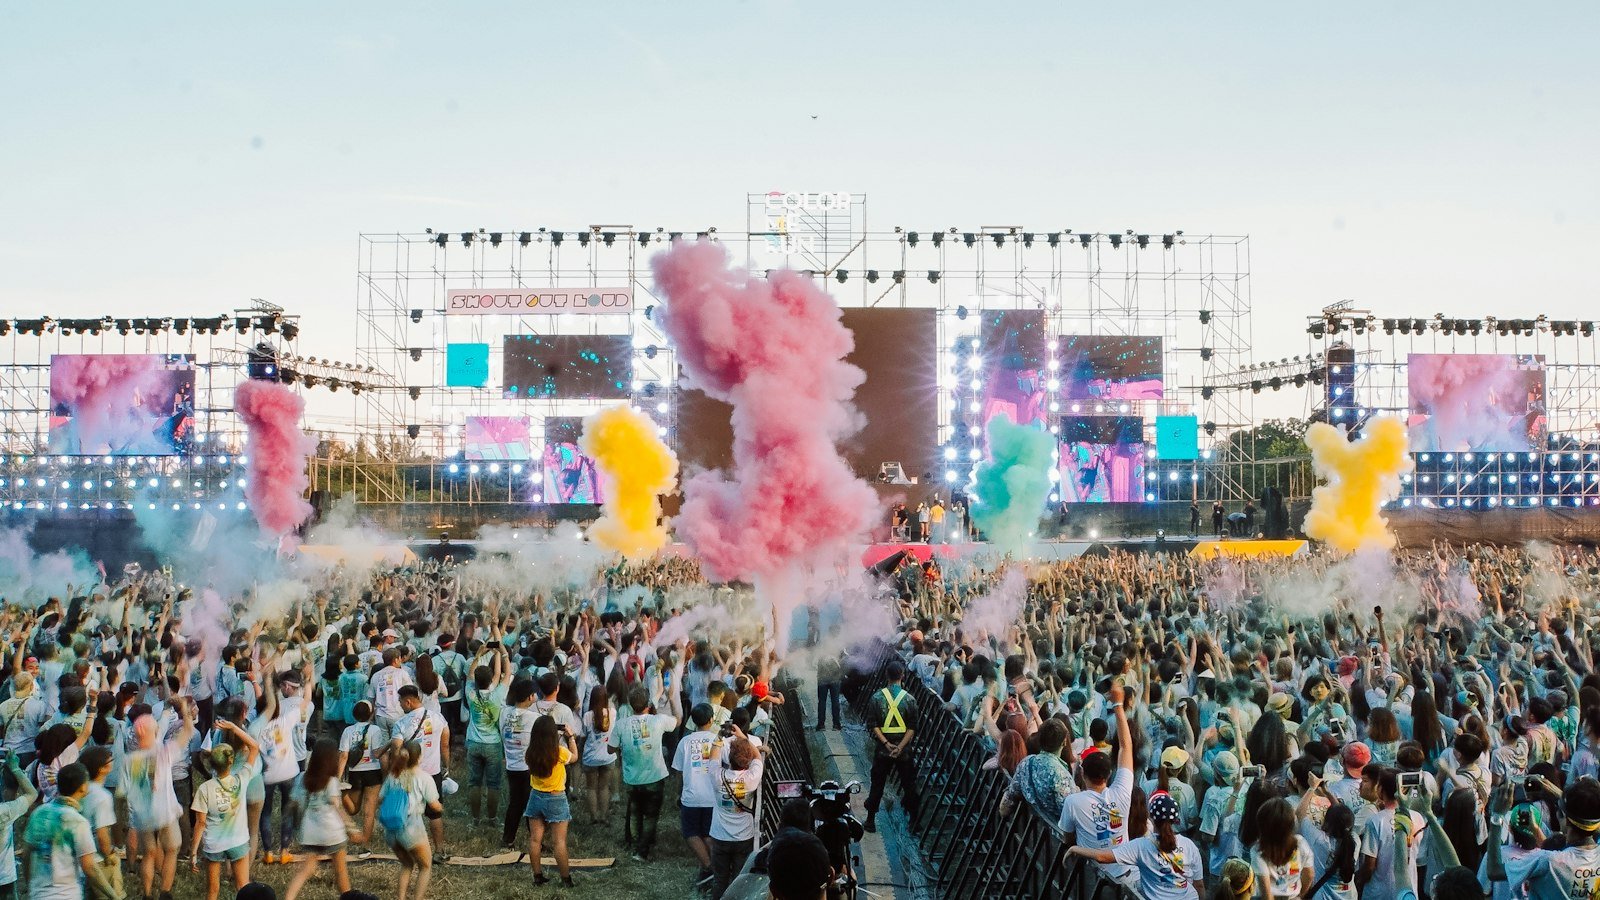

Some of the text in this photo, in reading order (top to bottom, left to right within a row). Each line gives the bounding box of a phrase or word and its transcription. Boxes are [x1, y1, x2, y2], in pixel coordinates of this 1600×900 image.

[765, 191, 851, 210] COLOR
[766, 213, 800, 232] ME
[765, 235, 814, 254] RUN
[451, 293, 629, 309] SHOUT OUT LOUD
[1091, 801, 1117, 810] COLOR
[1093, 814, 1110, 824] RUN
[1575, 867, 1600, 878] COLO
[1571, 888, 1594, 897] RUN
